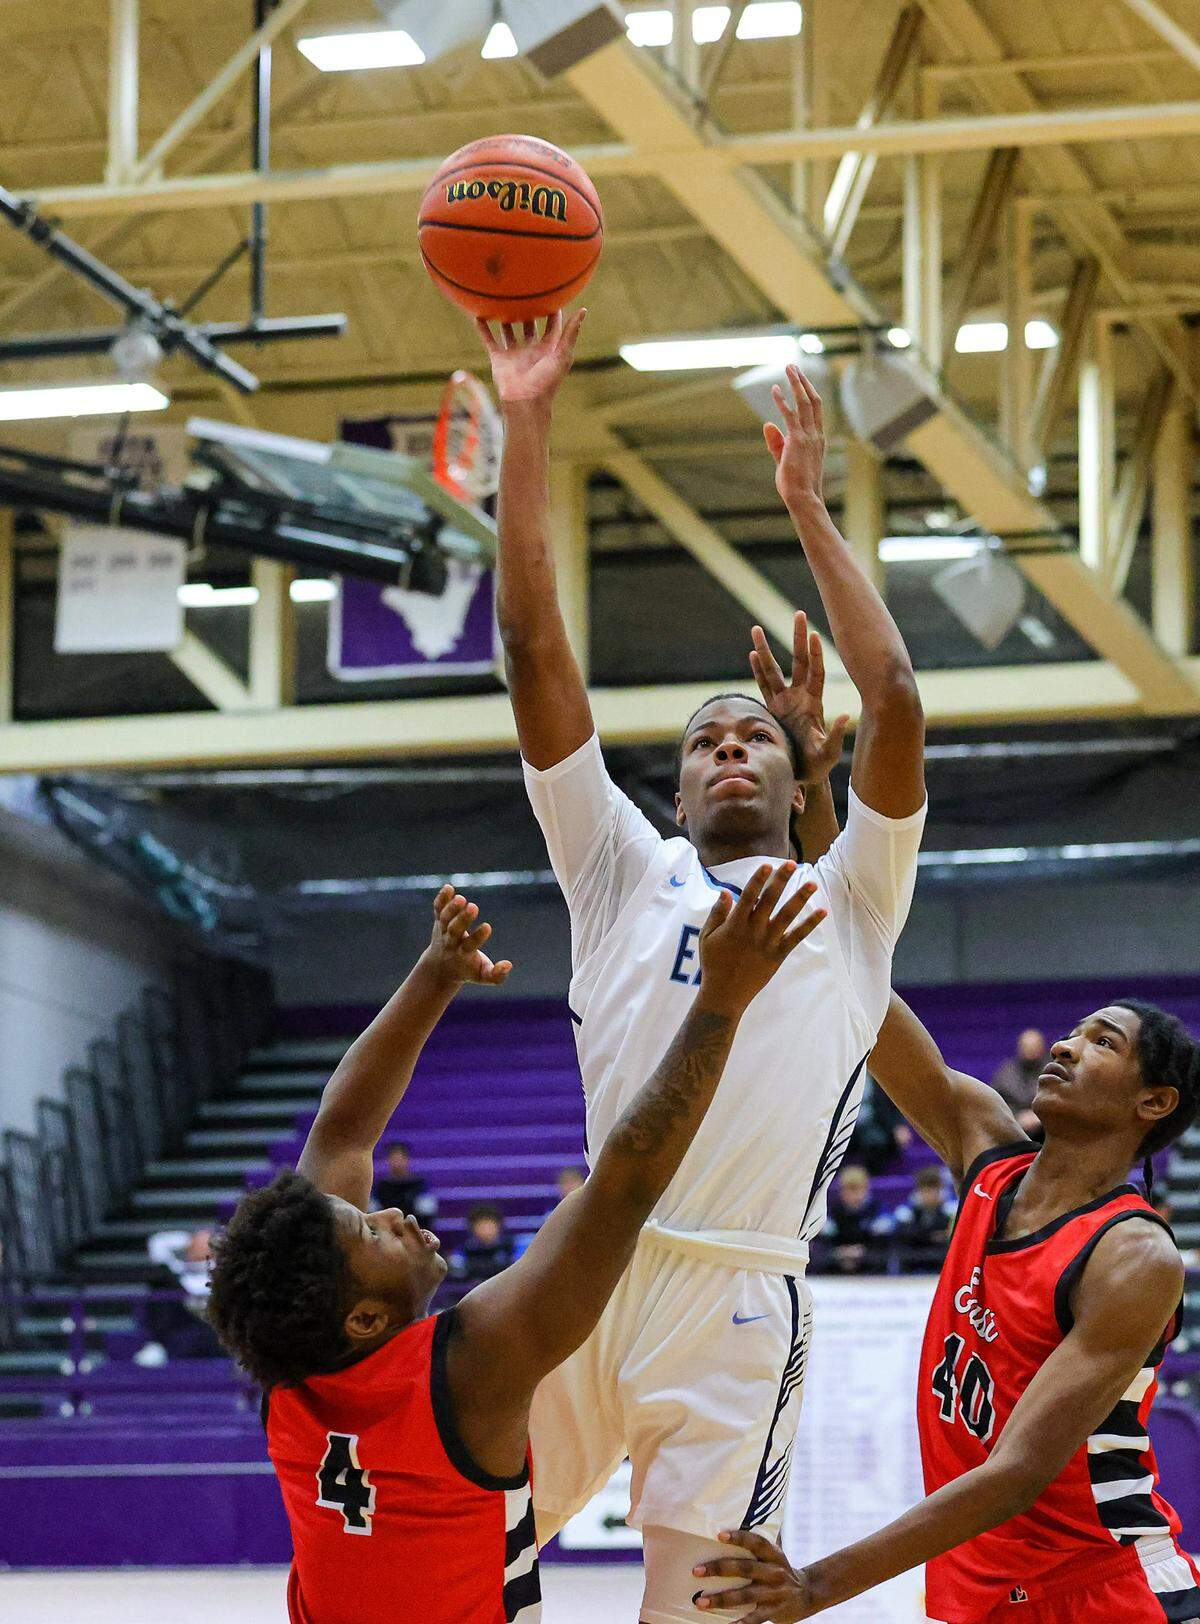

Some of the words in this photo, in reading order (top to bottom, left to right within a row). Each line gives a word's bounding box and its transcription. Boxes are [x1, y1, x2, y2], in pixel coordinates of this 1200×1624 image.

[445, 179, 568, 222] Wilson
[669, 923, 702, 986] E
[931, 1332, 996, 1445] 40
[315, 1431, 377, 1536] 4
